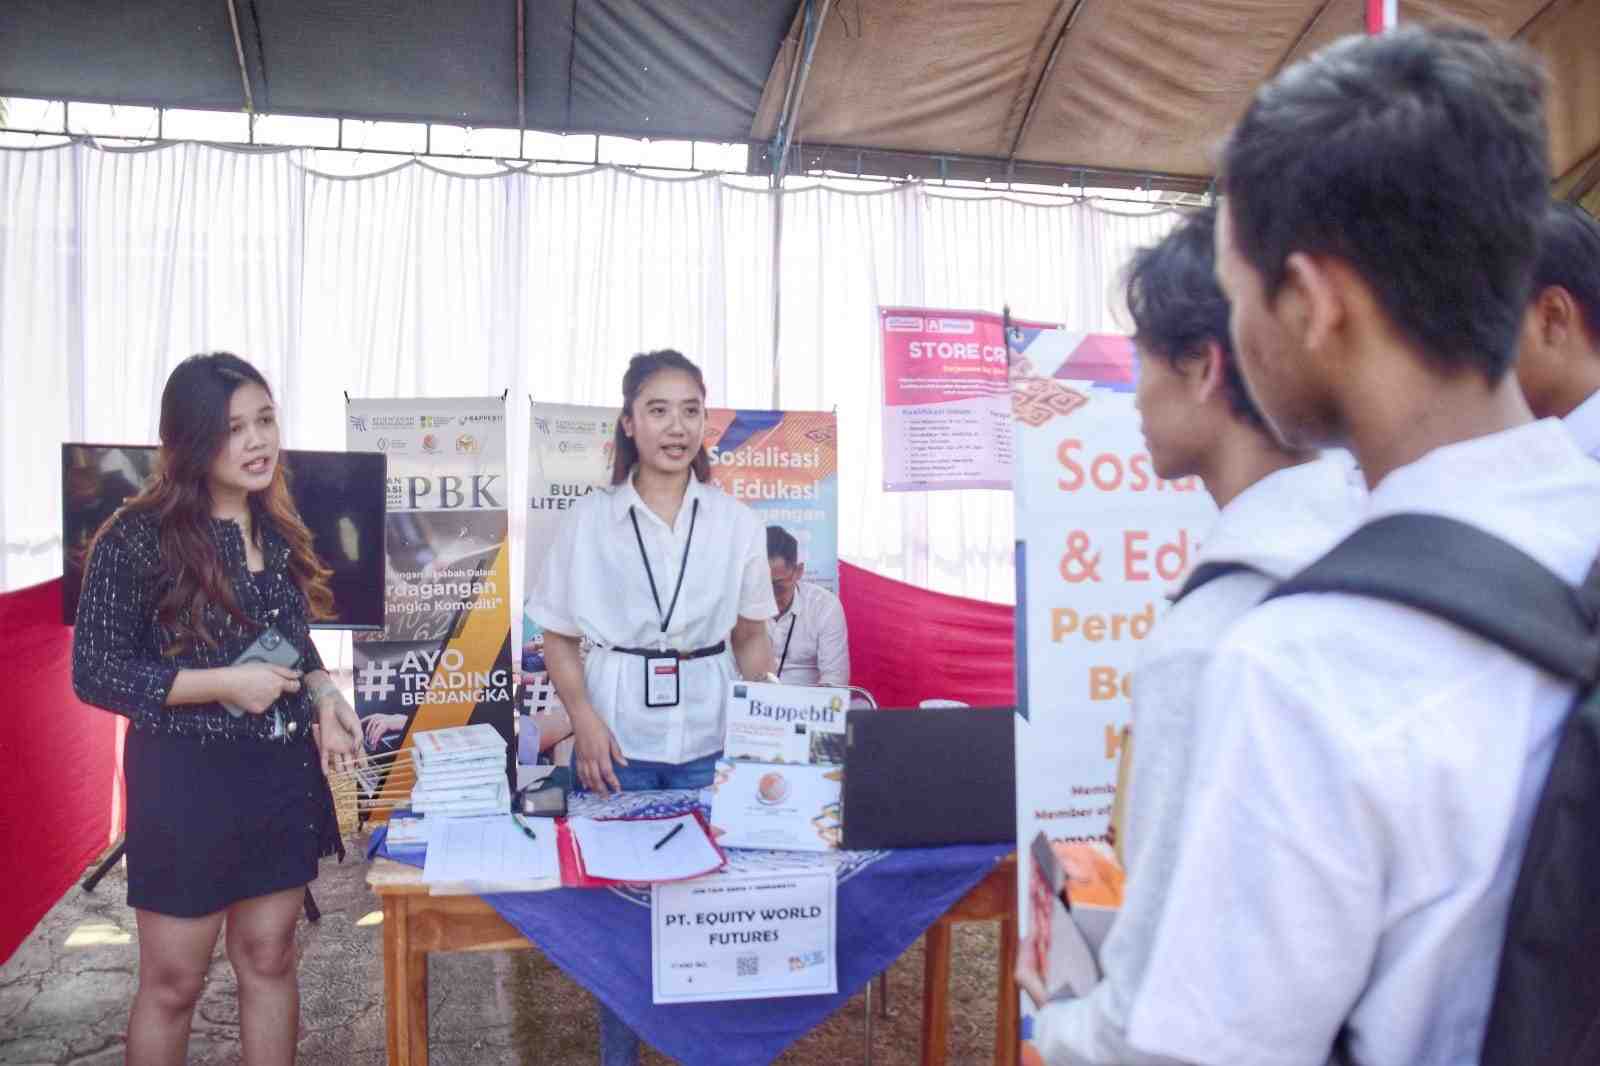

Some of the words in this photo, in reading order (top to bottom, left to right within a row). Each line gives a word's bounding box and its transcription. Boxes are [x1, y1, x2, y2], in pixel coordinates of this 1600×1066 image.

[909, 341, 981, 359] STORE
[706, 446, 820, 467] Sosialisasi
[1056, 438, 1196, 492] Sos
[406, 475, 503, 509] PBK
[1059, 529, 1102, 583] &
[467, 568, 496, 577] Dalam
[1050, 601, 1155, 642] Perd
[401, 650, 464, 672] AYO
[401, 670, 508, 691] TRADING
[401, 689, 510, 706] BERJANGKA
[750, 699, 836, 722] Bappebti
[665, 914, 691, 928] PT.
[696, 910, 756, 926] EQUITY
[760, 906, 822, 922] WORLD
[708, 929, 780, 945] FUTURES
